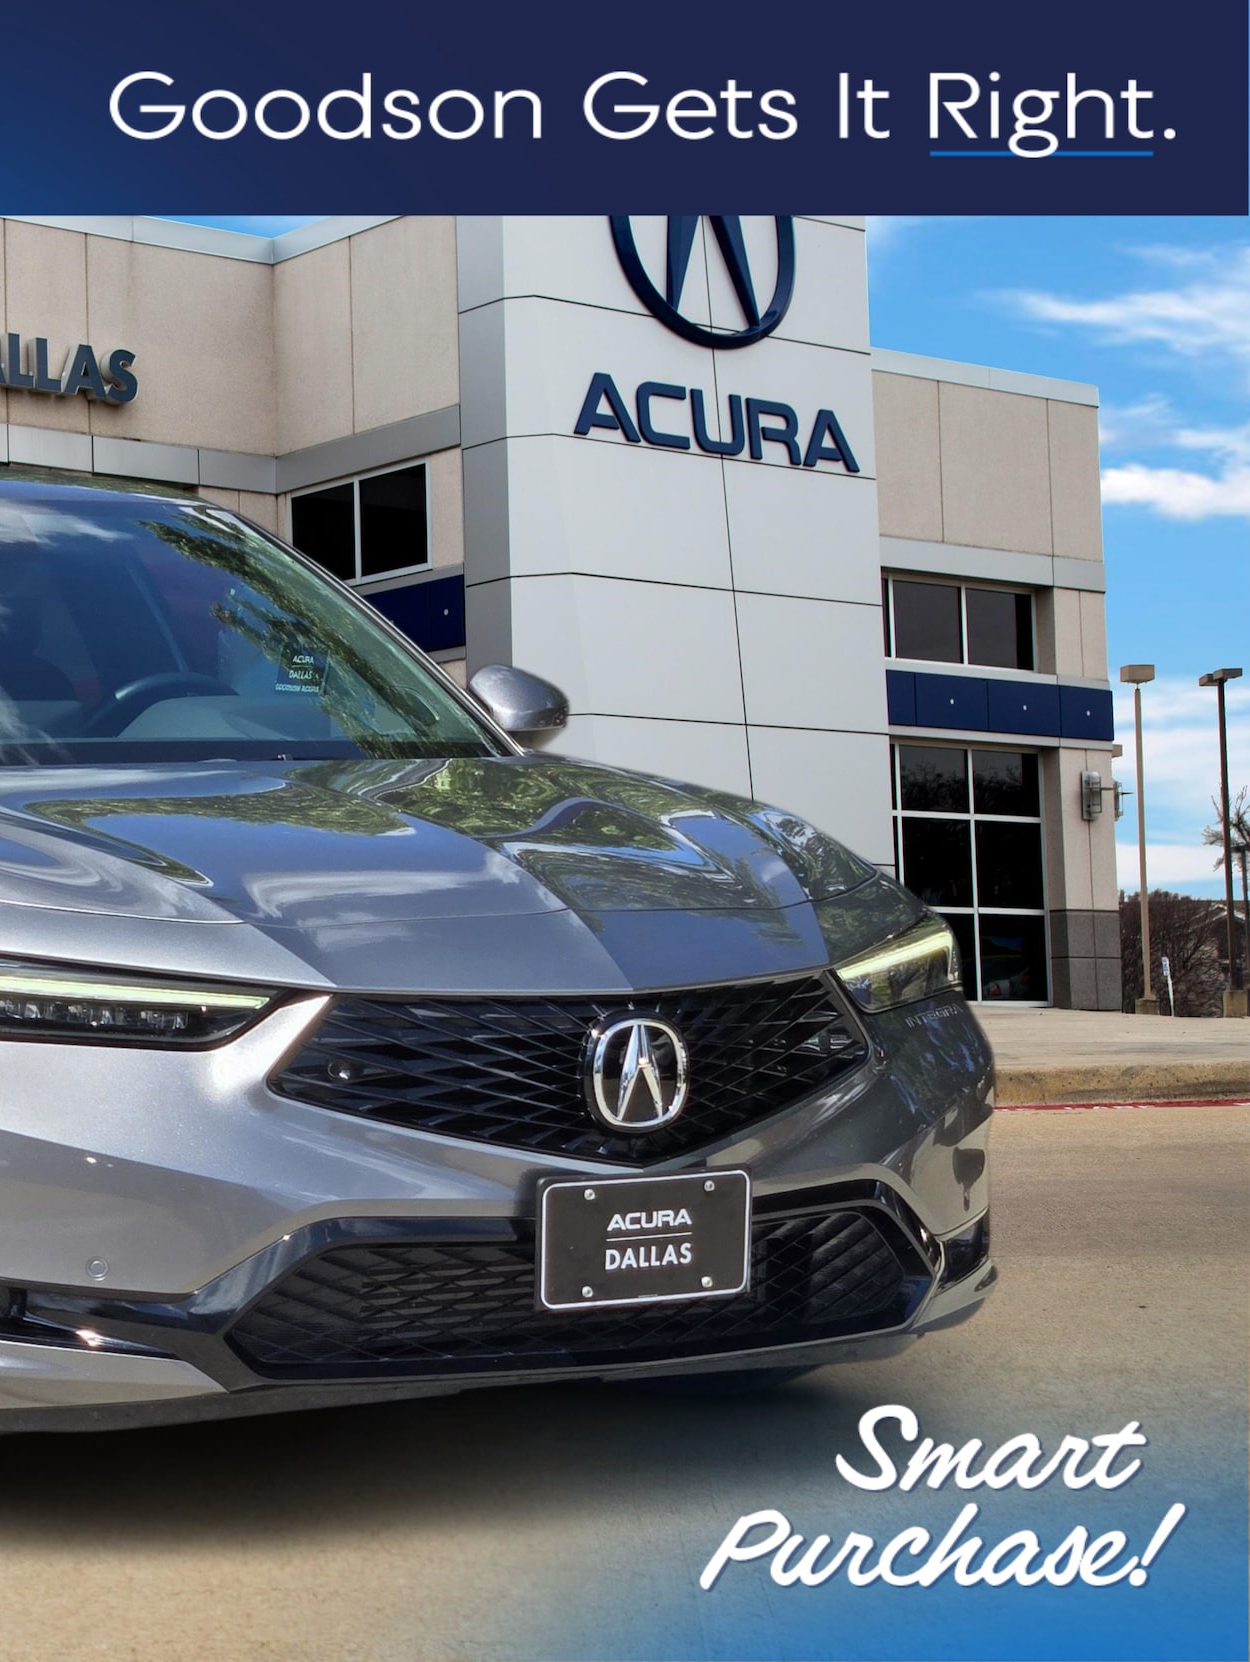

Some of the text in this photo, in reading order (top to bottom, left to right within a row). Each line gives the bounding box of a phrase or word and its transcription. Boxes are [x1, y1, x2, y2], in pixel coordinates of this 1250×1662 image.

[573, 371, 860, 473] ACURA
[292, 655, 314, 665] ACURA
[288, 669, 313, 680] DALLAS
[606, 1208, 693, 1232] ACURA
[605, 1242, 693, 1271] DALLAS
